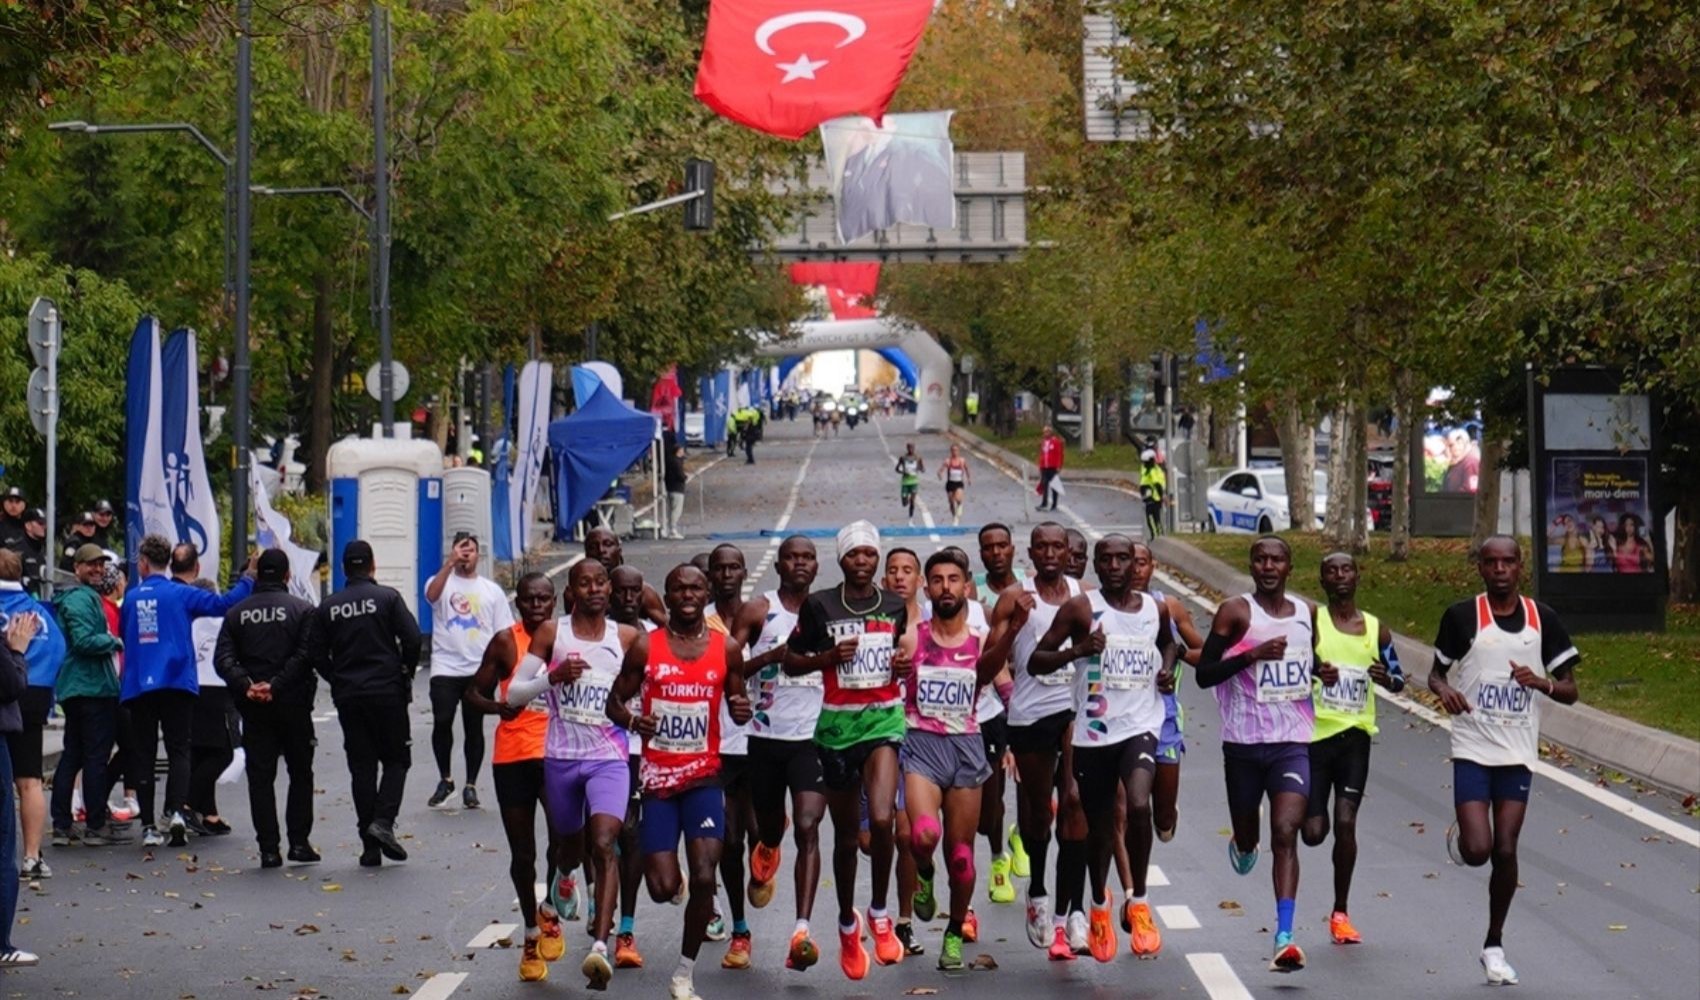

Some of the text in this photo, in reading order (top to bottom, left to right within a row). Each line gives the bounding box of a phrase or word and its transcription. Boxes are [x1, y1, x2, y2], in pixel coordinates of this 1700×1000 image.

[1260, 660, 1308, 688] ALEX
[661, 682, 714, 698] TÜRKİYE
[1478, 683, 1534, 712] KENNEDY
[655, 714, 708, 739] ABAN
